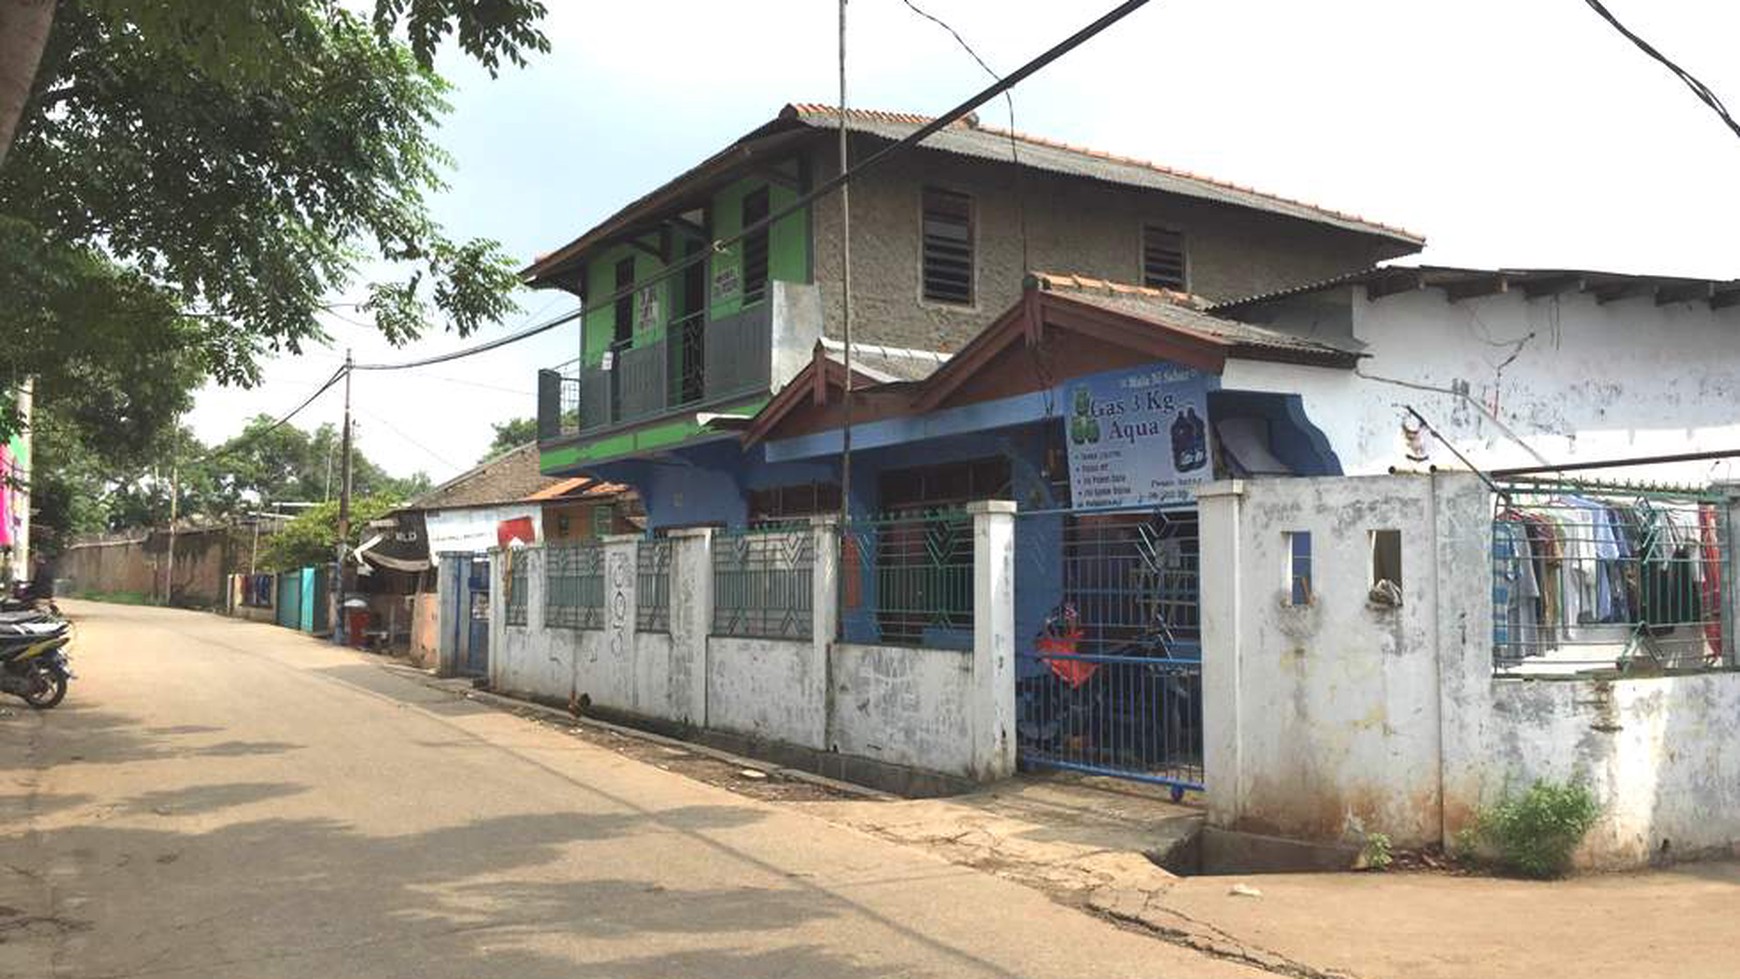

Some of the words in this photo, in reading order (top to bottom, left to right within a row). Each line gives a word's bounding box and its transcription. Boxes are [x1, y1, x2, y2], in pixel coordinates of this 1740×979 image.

[1090, 399, 1125, 418] Gas
[1147, 389, 1175, 413] Kg
[1108, 420, 1159, 444] Aqua
